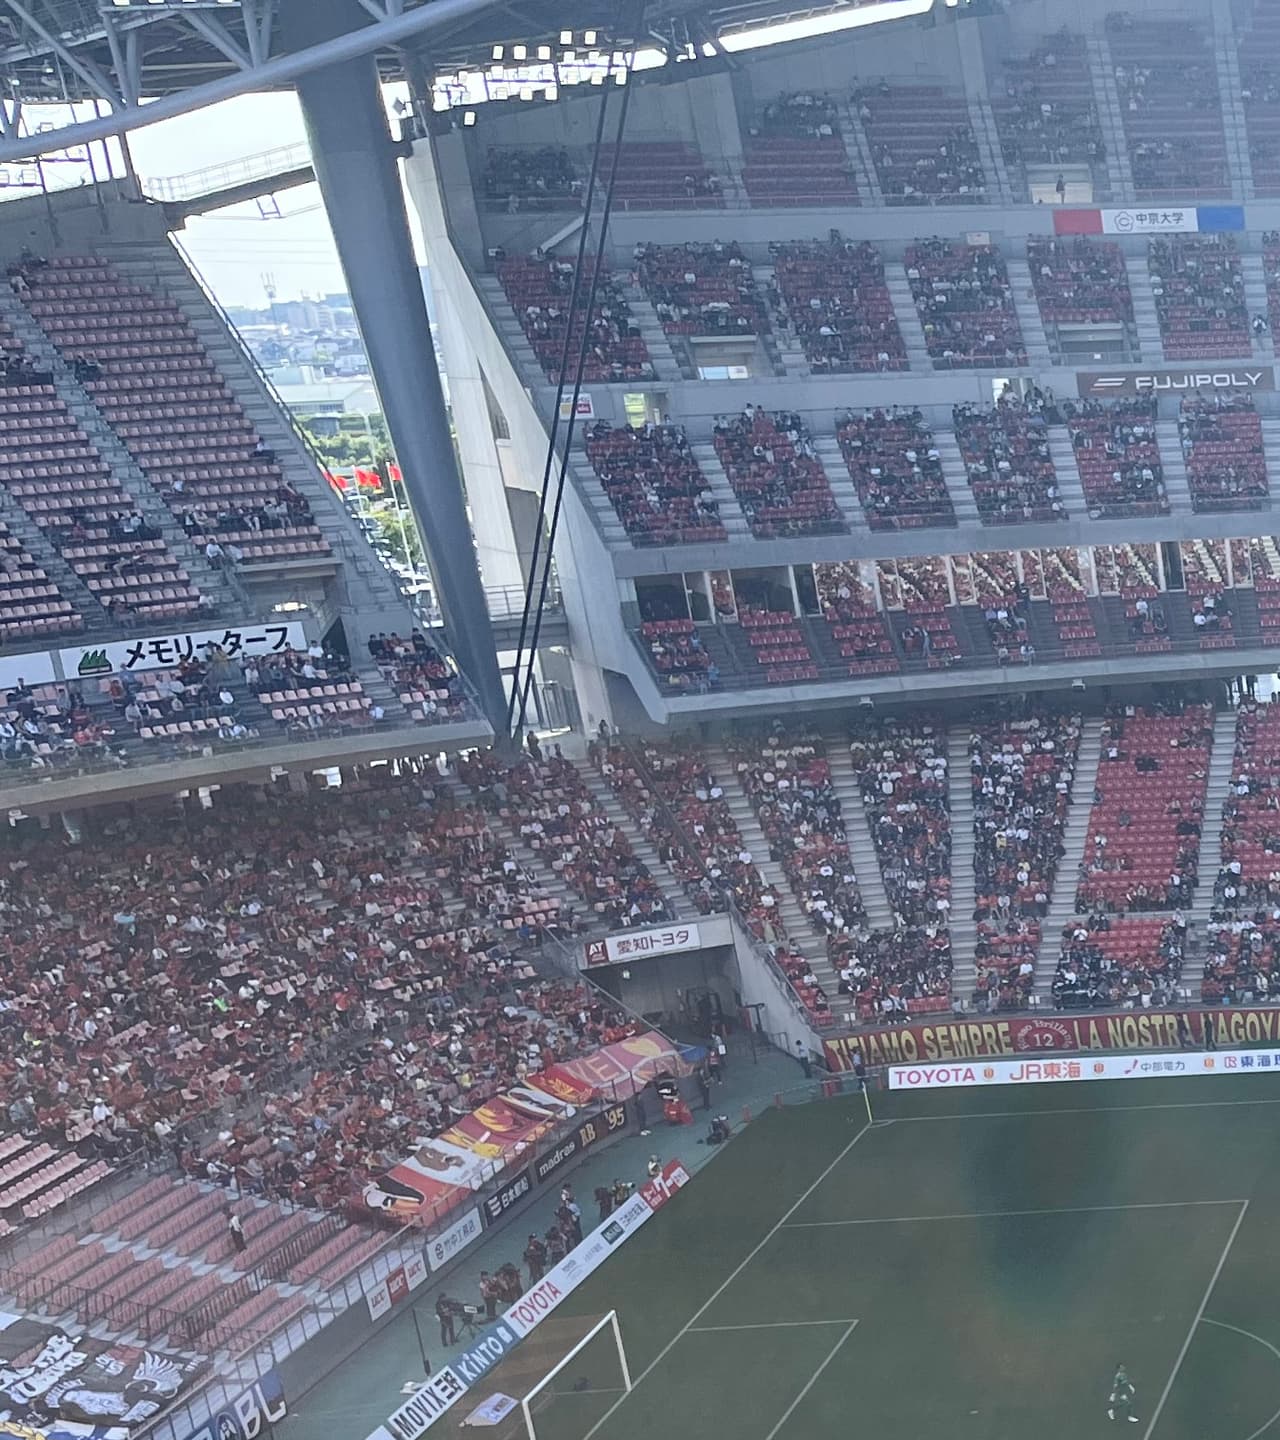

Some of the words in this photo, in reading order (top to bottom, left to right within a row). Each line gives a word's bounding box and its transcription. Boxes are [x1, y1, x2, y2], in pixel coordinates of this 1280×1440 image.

[1135, 212, 1184, 226] 中京大学
[1135, 371, 1264, 390] FUJIPOLY
[126, 625, 289, 669] メモリーターフ
[616, 929, 690, 955] 愛知トヨタ
[922, 1022, 1013, 1061] SEMPRE
[1033, 1033, 1054, 1047] 12
[1073, 1019, 1102, 1050] LA
[895, 1067, 976, 1085] TOYOTA
[1008, 1062, 1081, 1080] JR東海
[1140, 1061, 1186, 1073] 中部電力
[538, 1140, 576, 1177] madras
[509, 1280, 563, 1330] TOYOTA
[458, 1336, 505, 1382] KINTO
